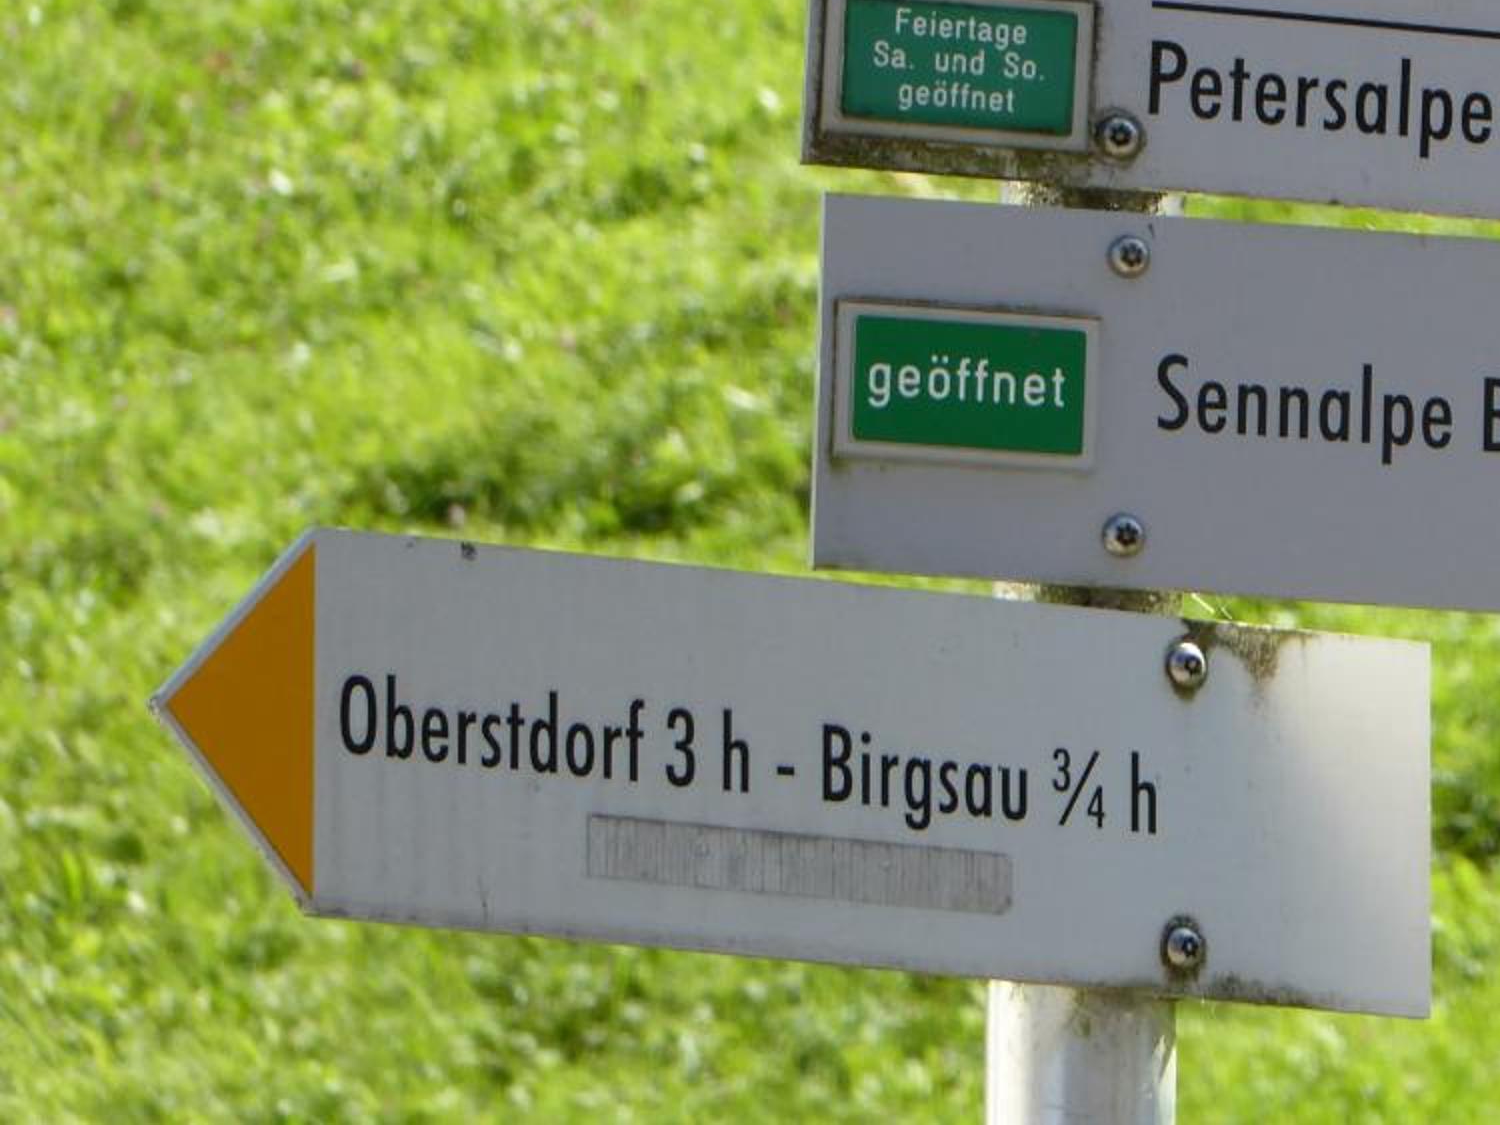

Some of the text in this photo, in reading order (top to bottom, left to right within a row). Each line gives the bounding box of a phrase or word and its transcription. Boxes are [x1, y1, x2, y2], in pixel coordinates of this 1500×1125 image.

[895, 6, 1029, 47] Feiertage
[872, 38, 1045, 82] Sa. und So.
[897, 78, 1015, 114] geöffnet
[1146, 40, 1494, 160] Petersalpe
[866, 353, 1067, 410] geöffnet
[1156, 352, 1454, 467] Sennalpe
[338, 672, 646, 784] Oberstdorf
[664, 706, 697, 789] 3
[721, 707, 751, 795] h
[821, 722, 1029, 832] Birgsau
[1129, 749, 1158, 836] h
